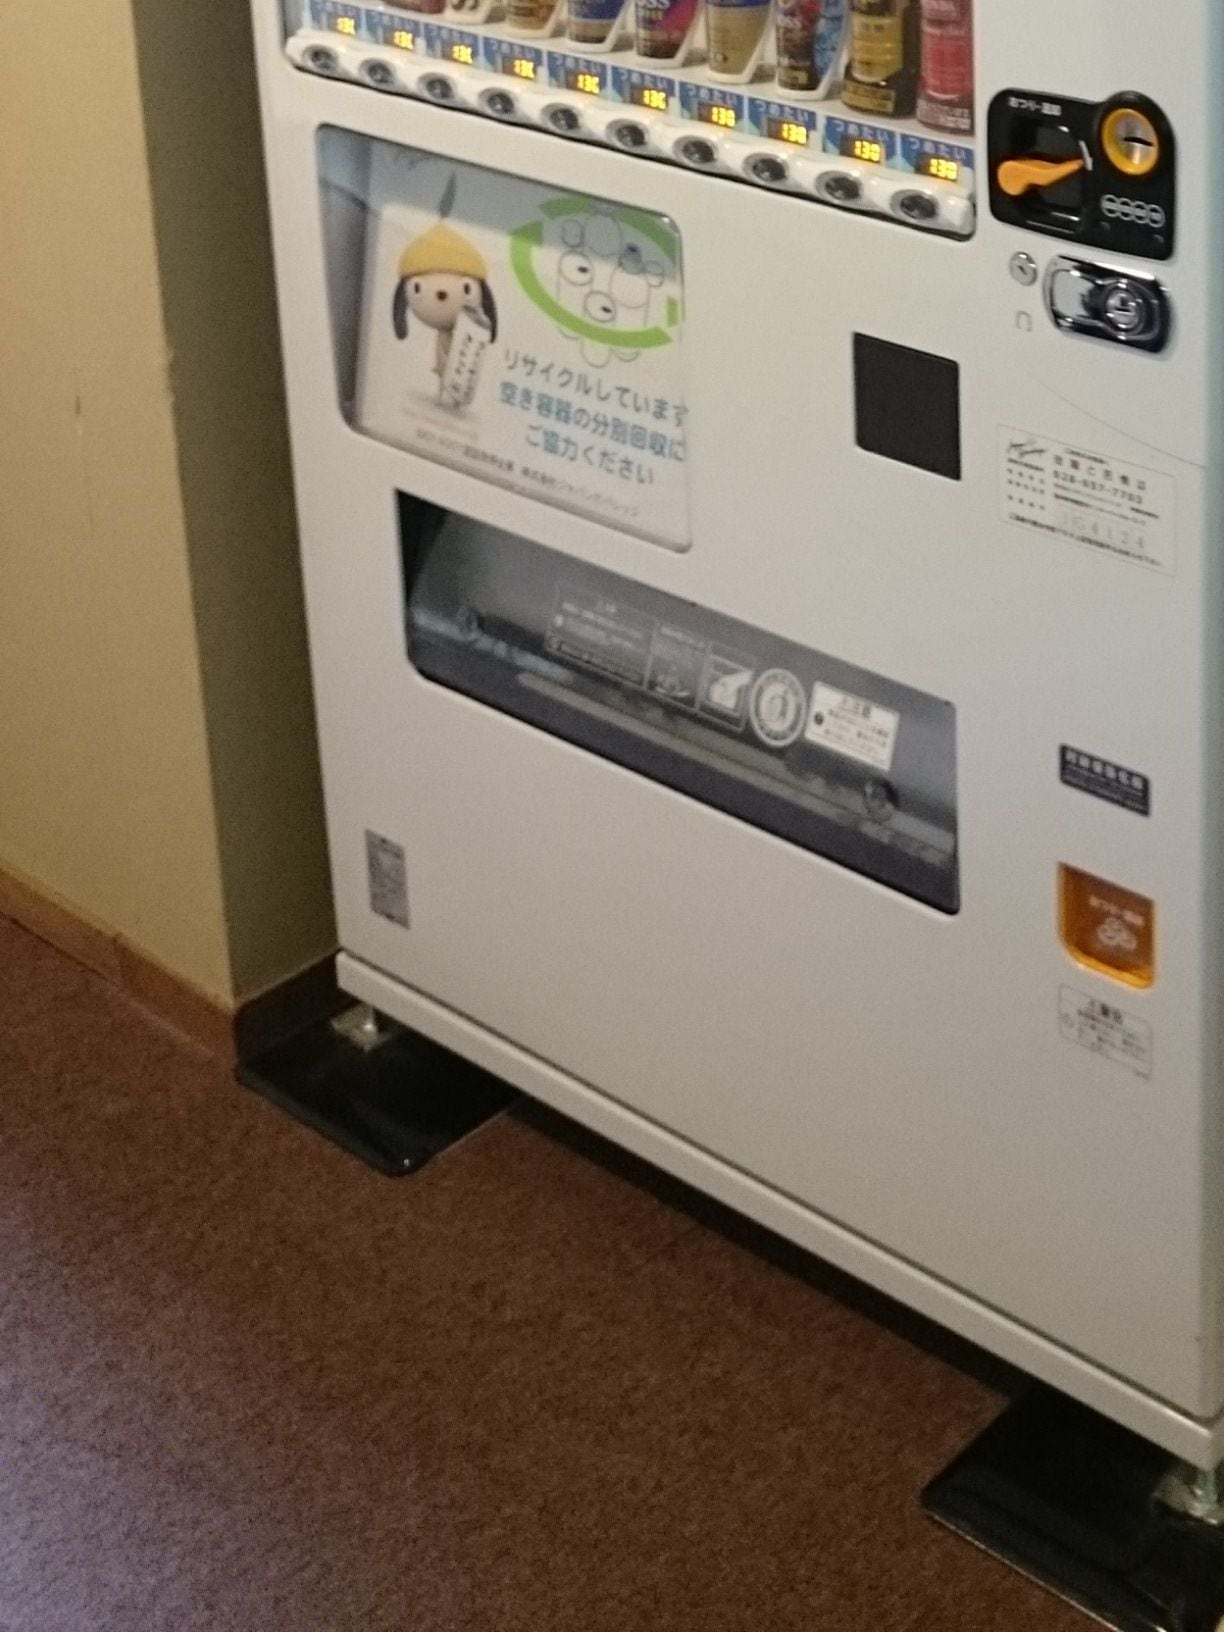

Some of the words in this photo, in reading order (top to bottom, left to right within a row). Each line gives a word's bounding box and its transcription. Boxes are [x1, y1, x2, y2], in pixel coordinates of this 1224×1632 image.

[504, 348, 689, 428] リサイクルしています
[526, 423, 655, 485] ご協力ください
